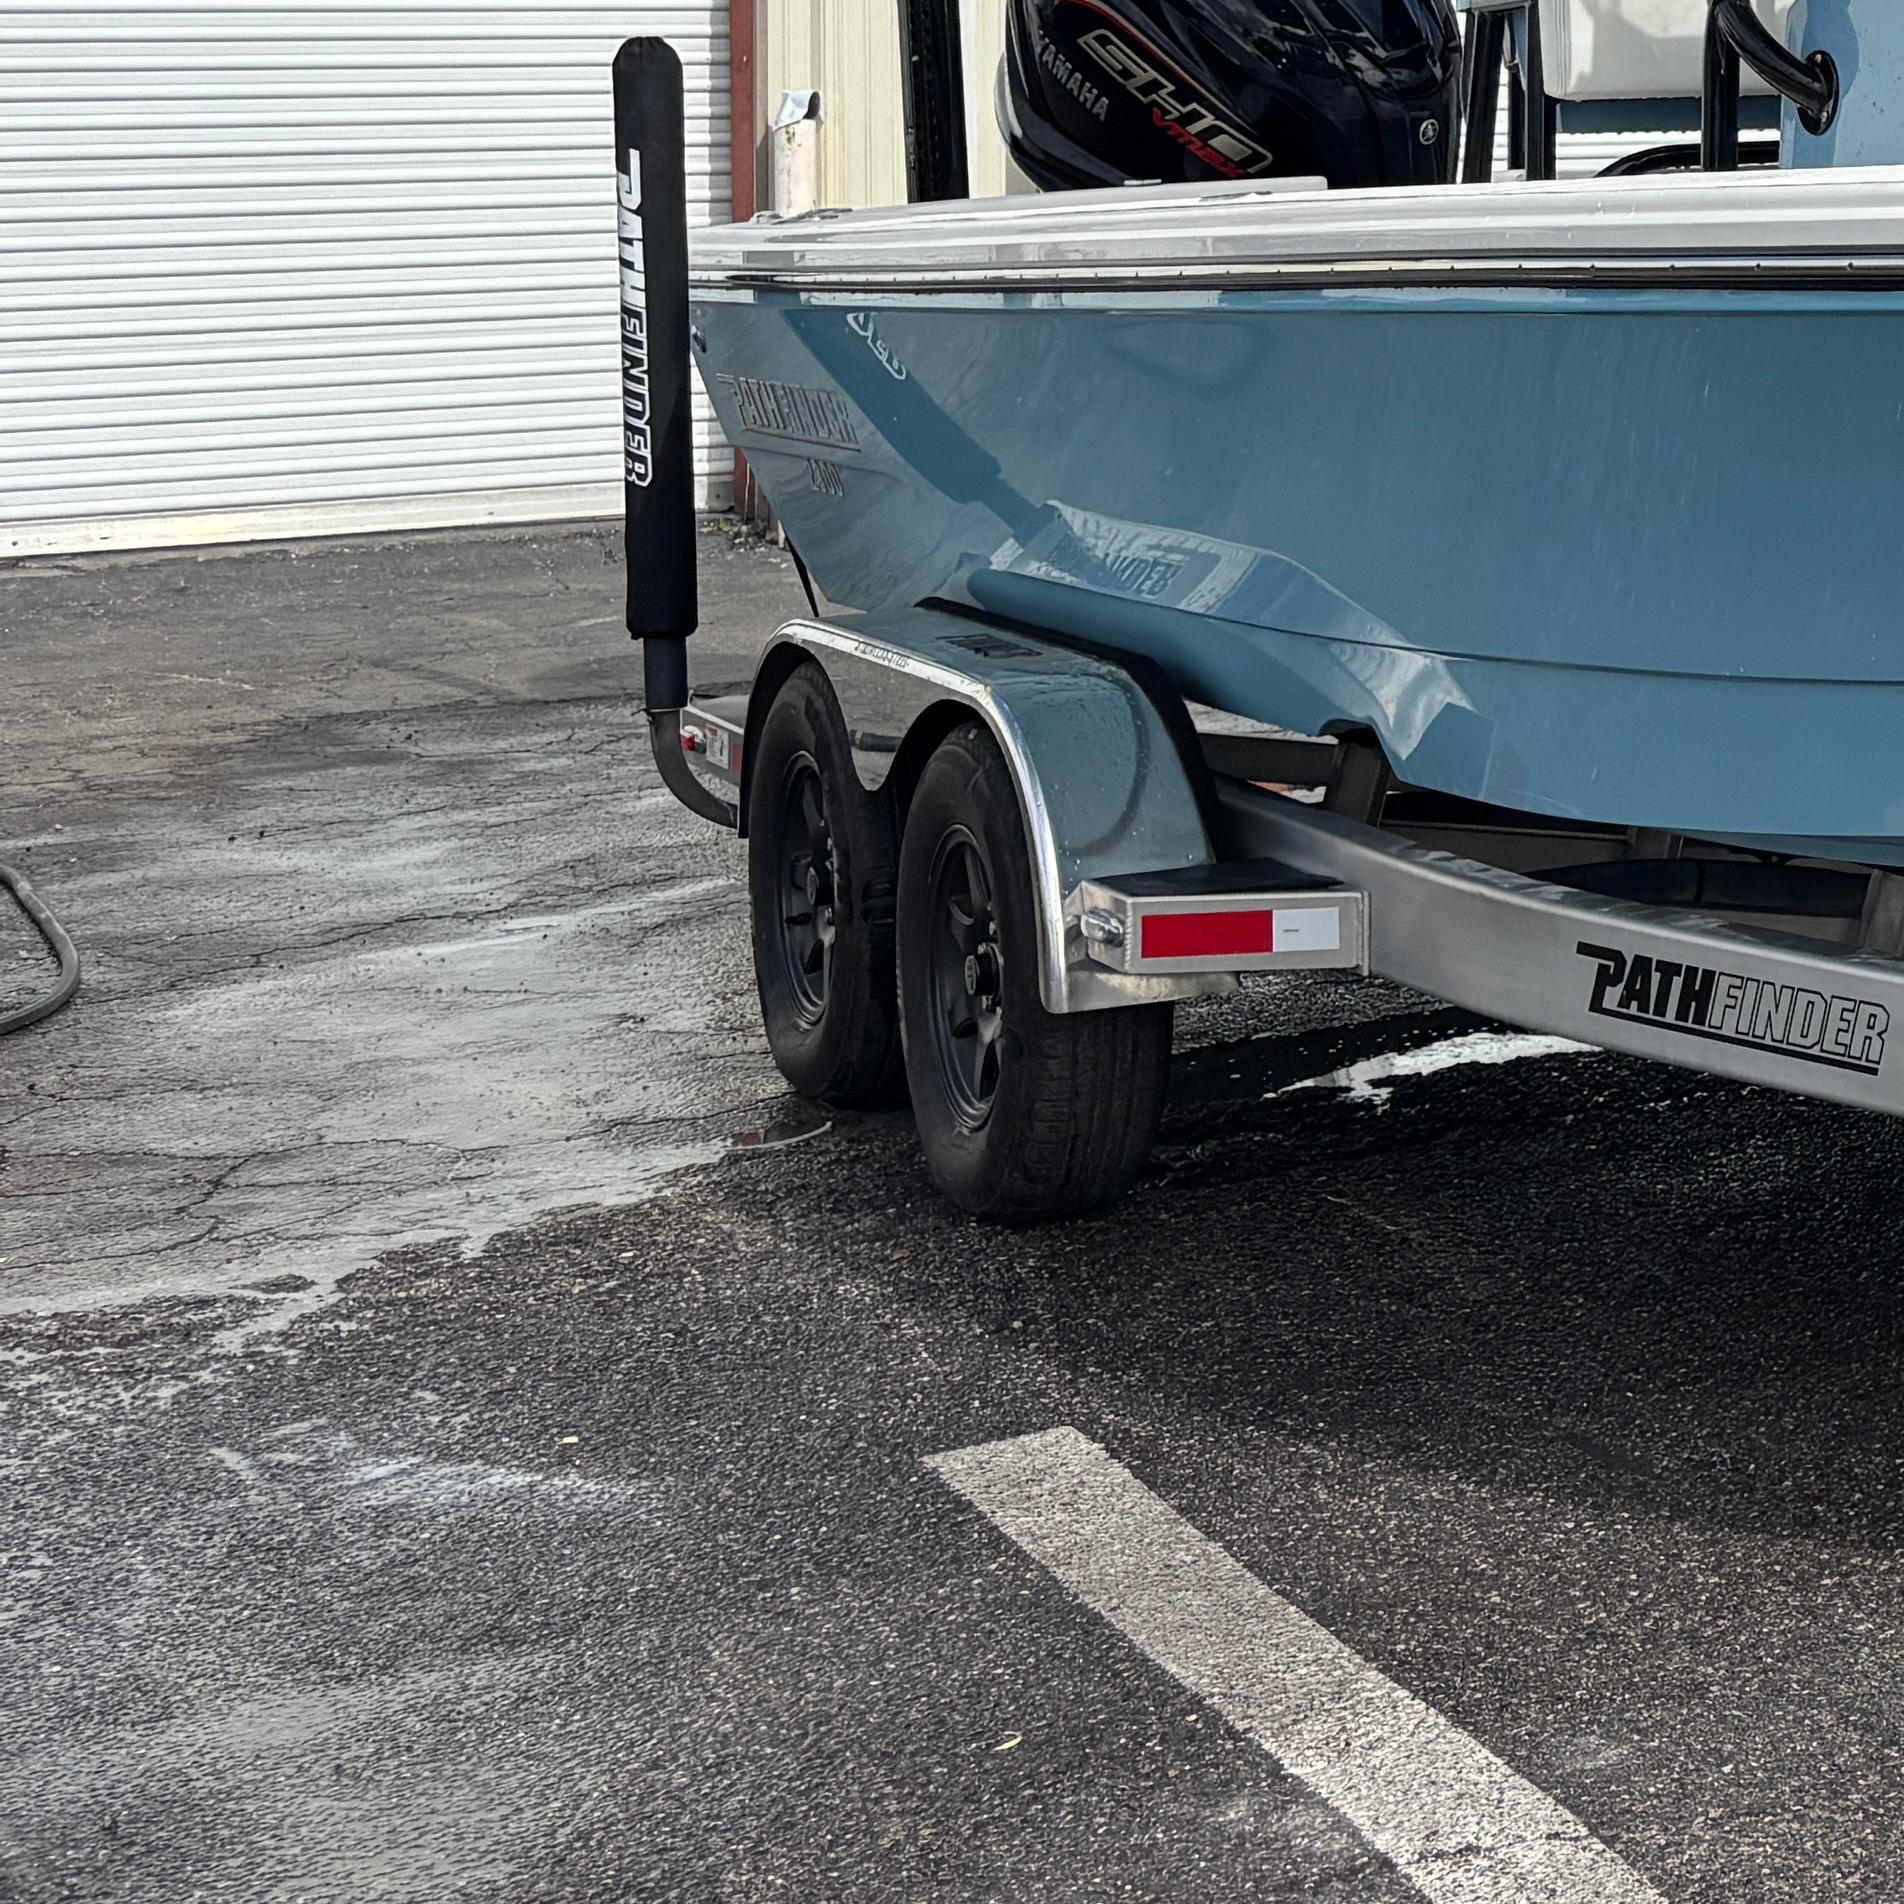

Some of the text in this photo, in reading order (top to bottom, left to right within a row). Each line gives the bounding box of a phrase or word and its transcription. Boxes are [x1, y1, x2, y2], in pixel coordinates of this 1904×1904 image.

[1077, 28, 1273, 174] SHO
[617, 147, 653, 489] PATHFINDER
[1576, 941, 1890, 1076] PATHFINDER
